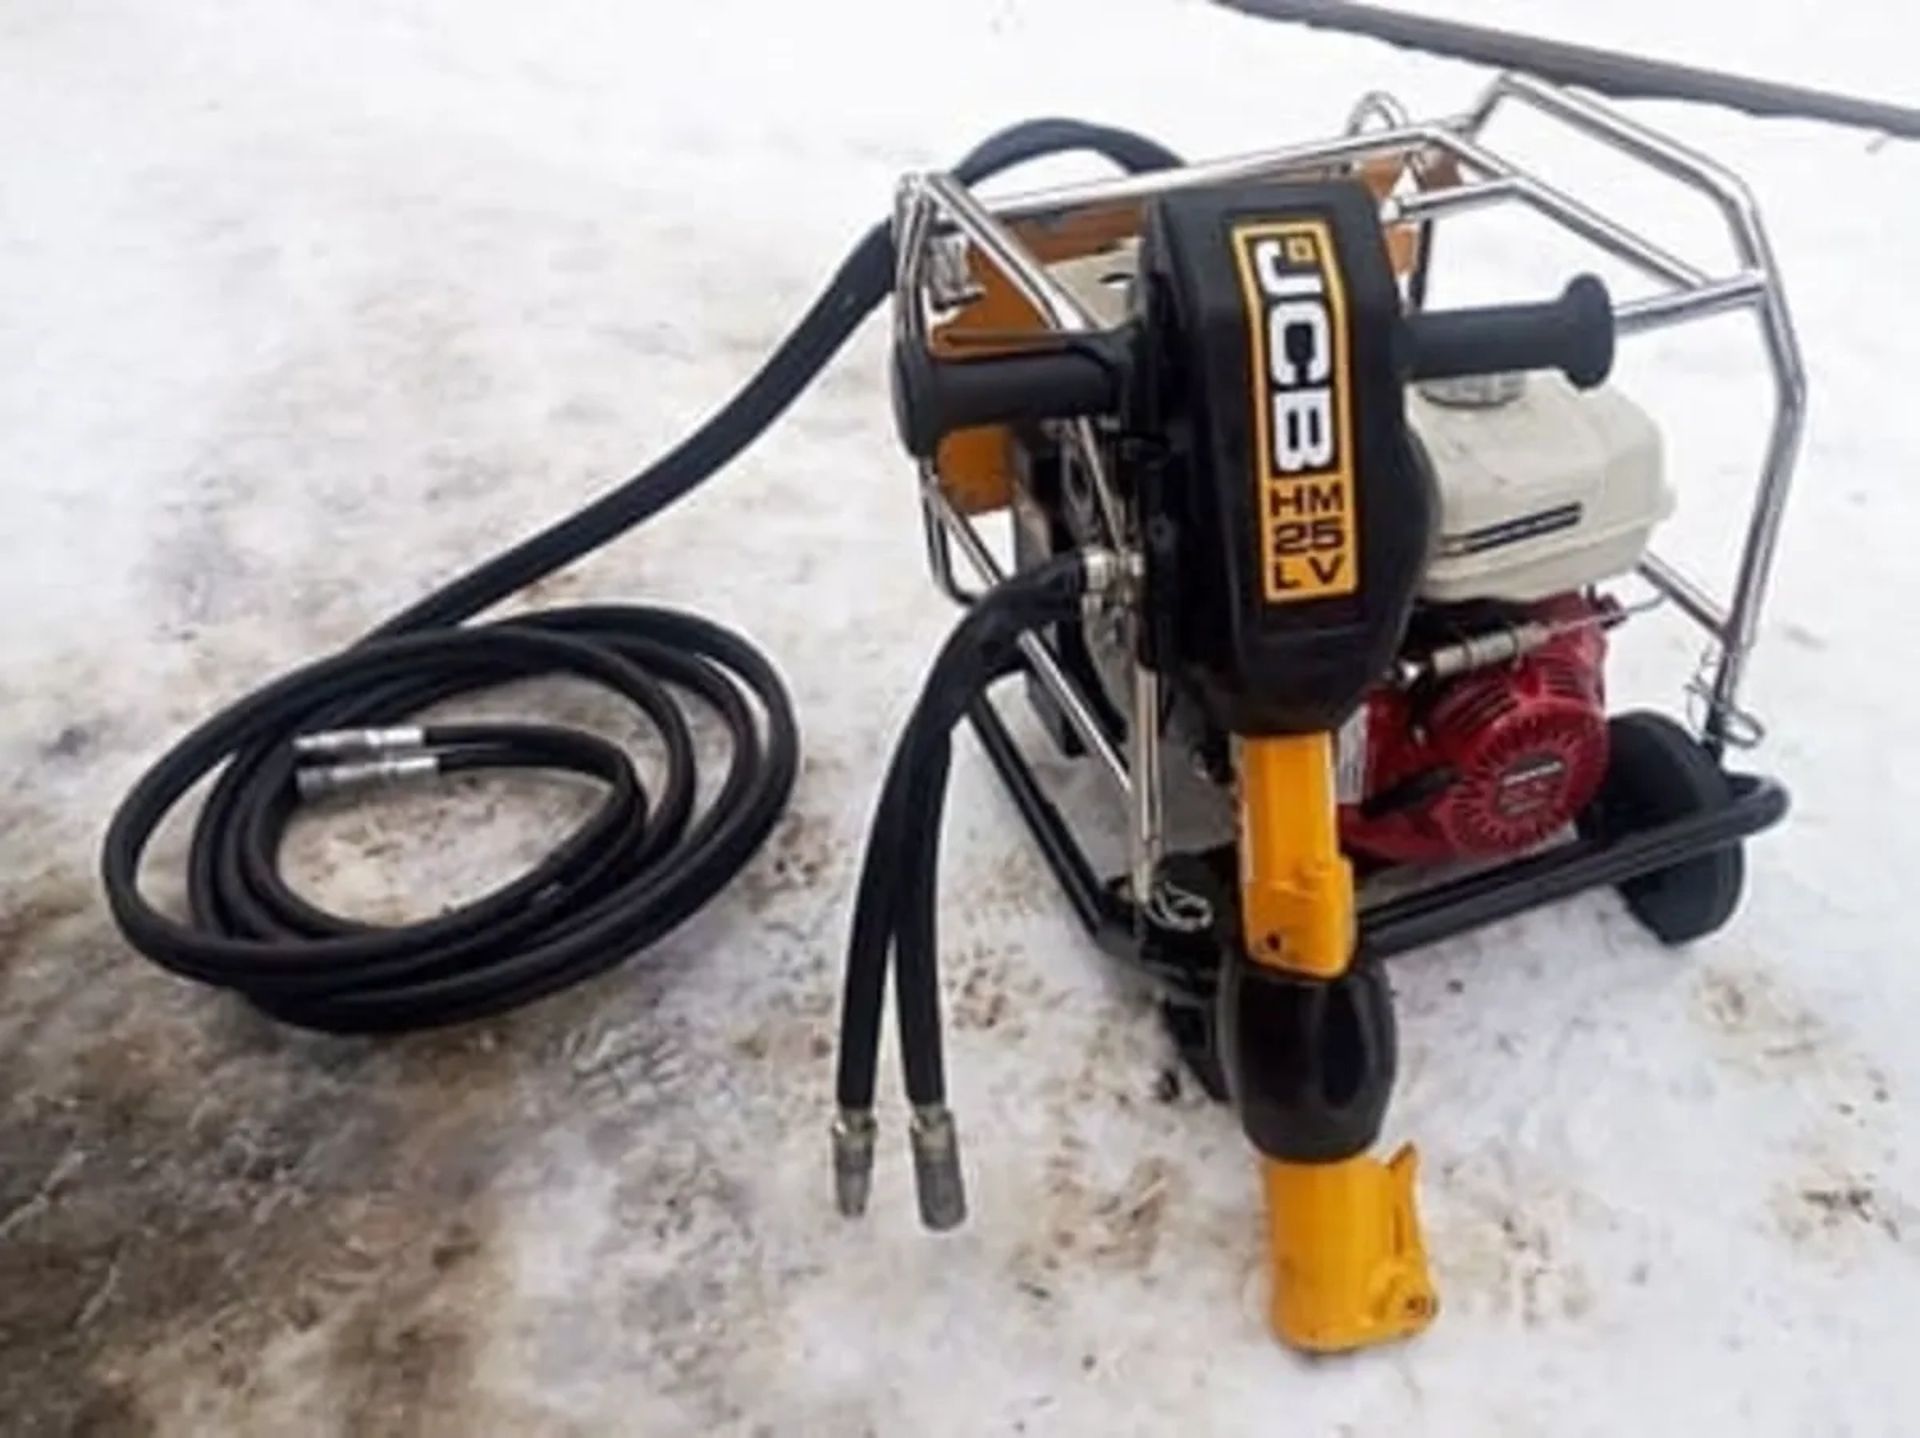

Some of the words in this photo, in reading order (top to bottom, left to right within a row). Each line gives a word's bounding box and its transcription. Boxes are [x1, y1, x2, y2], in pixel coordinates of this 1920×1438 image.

[1255, 240, 1333, 471] JCB
[1271, 482, 1345, 516] HM
[1274, 519, 1345, 554] 25
